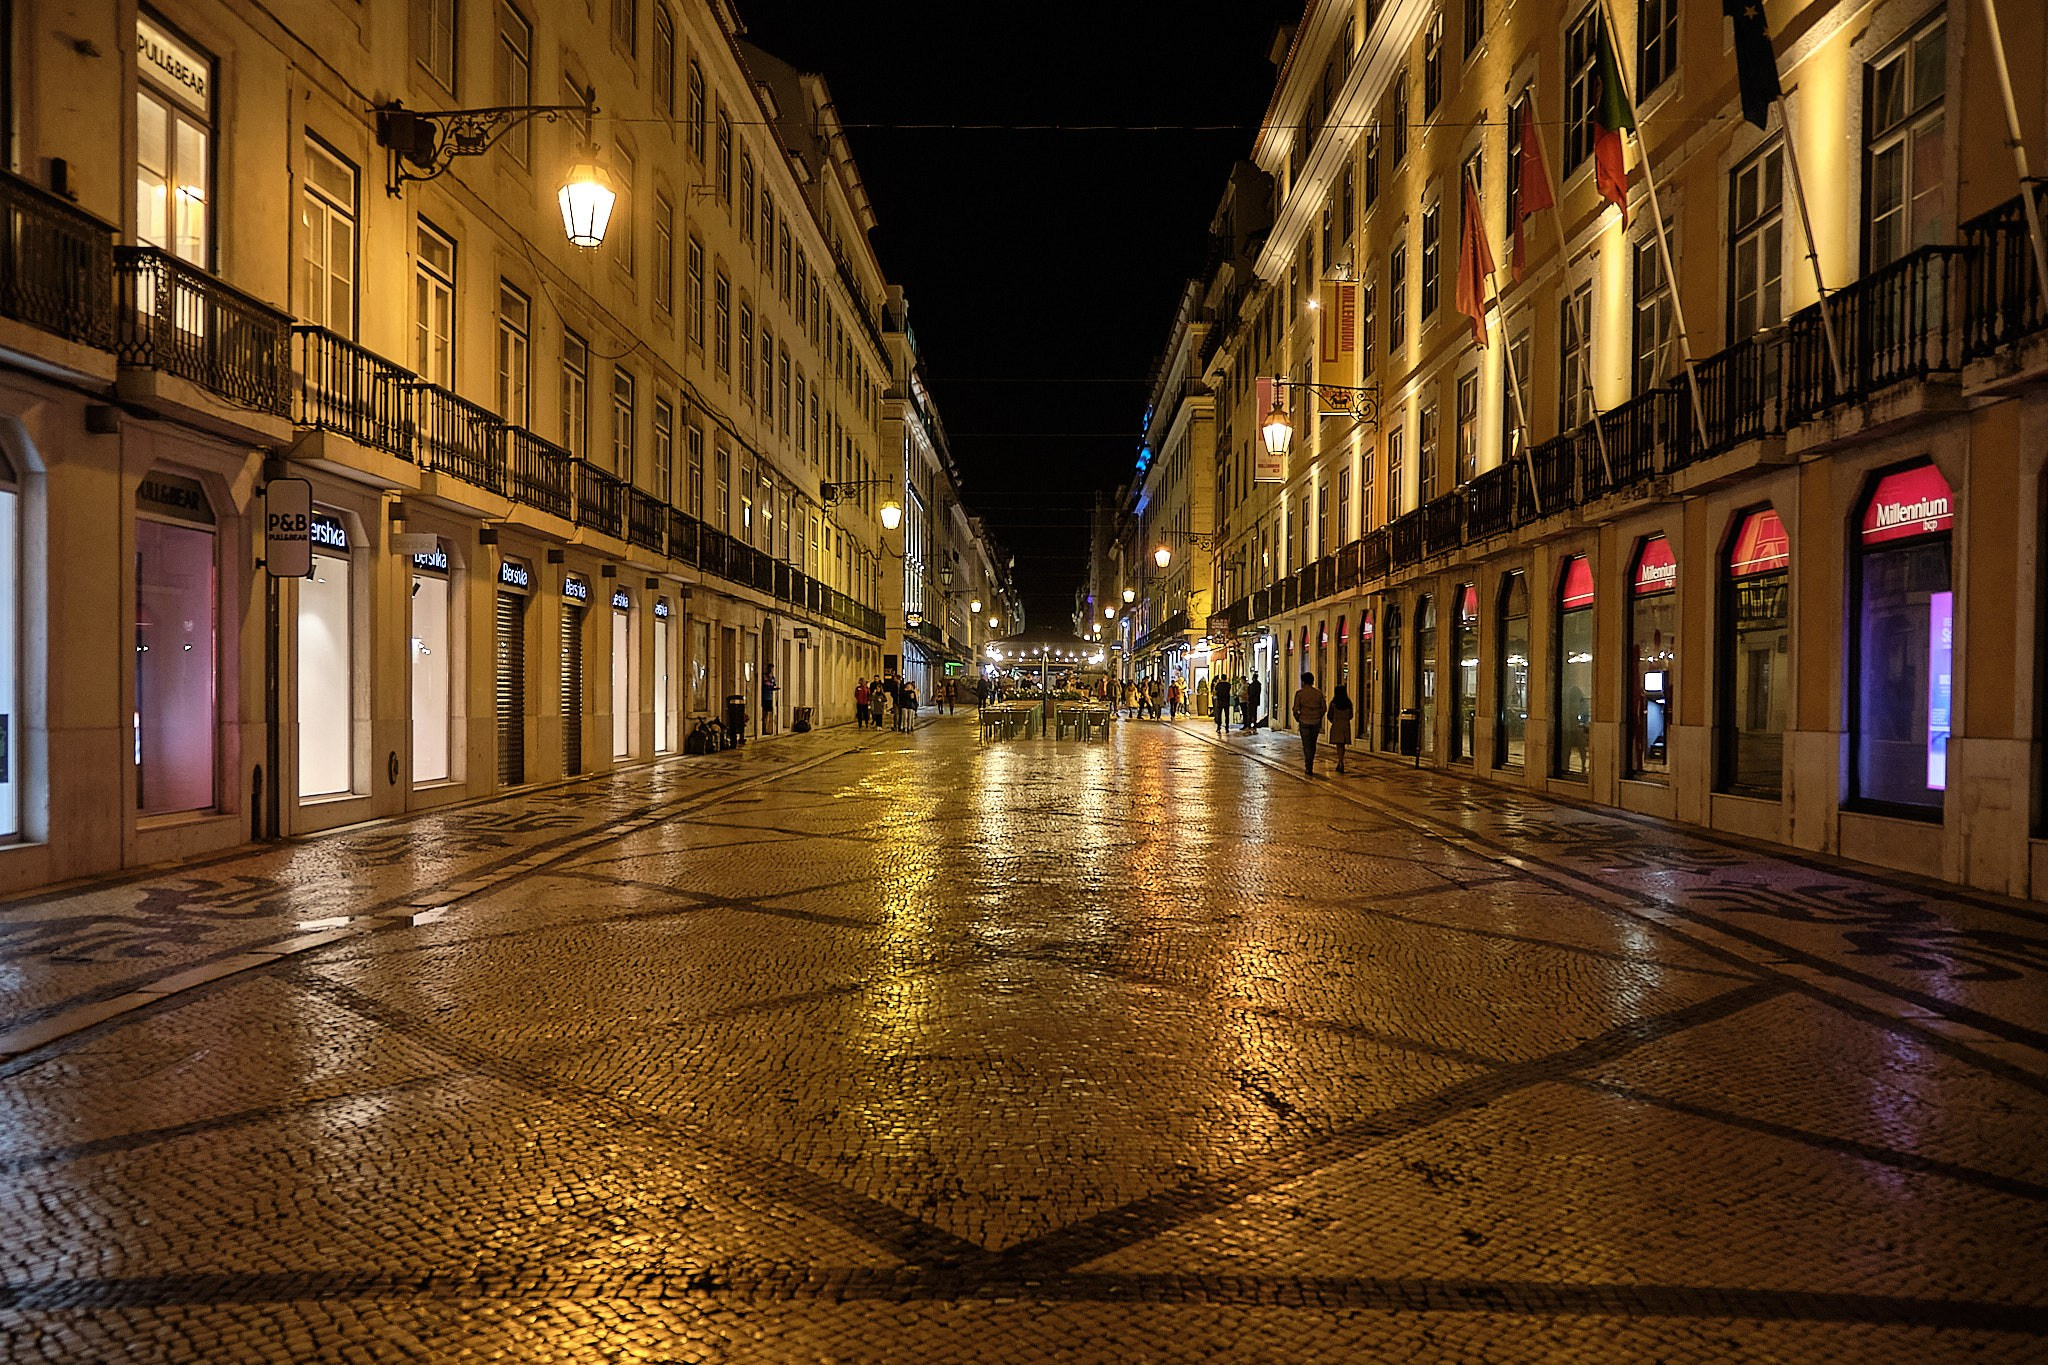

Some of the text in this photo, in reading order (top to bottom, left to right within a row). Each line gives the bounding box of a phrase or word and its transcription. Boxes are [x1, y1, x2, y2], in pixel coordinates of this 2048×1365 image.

[137, 33, 206, 97] PULL&BEAR
[1342, 285, 1356, 352] MILLENNIUM
[268, 513, 308, 532] P&B
[1876, 497, 1948, 528] Millennium
[311, 521, 346, 547] ershka
[502, 562, 528, 586] Bershka
